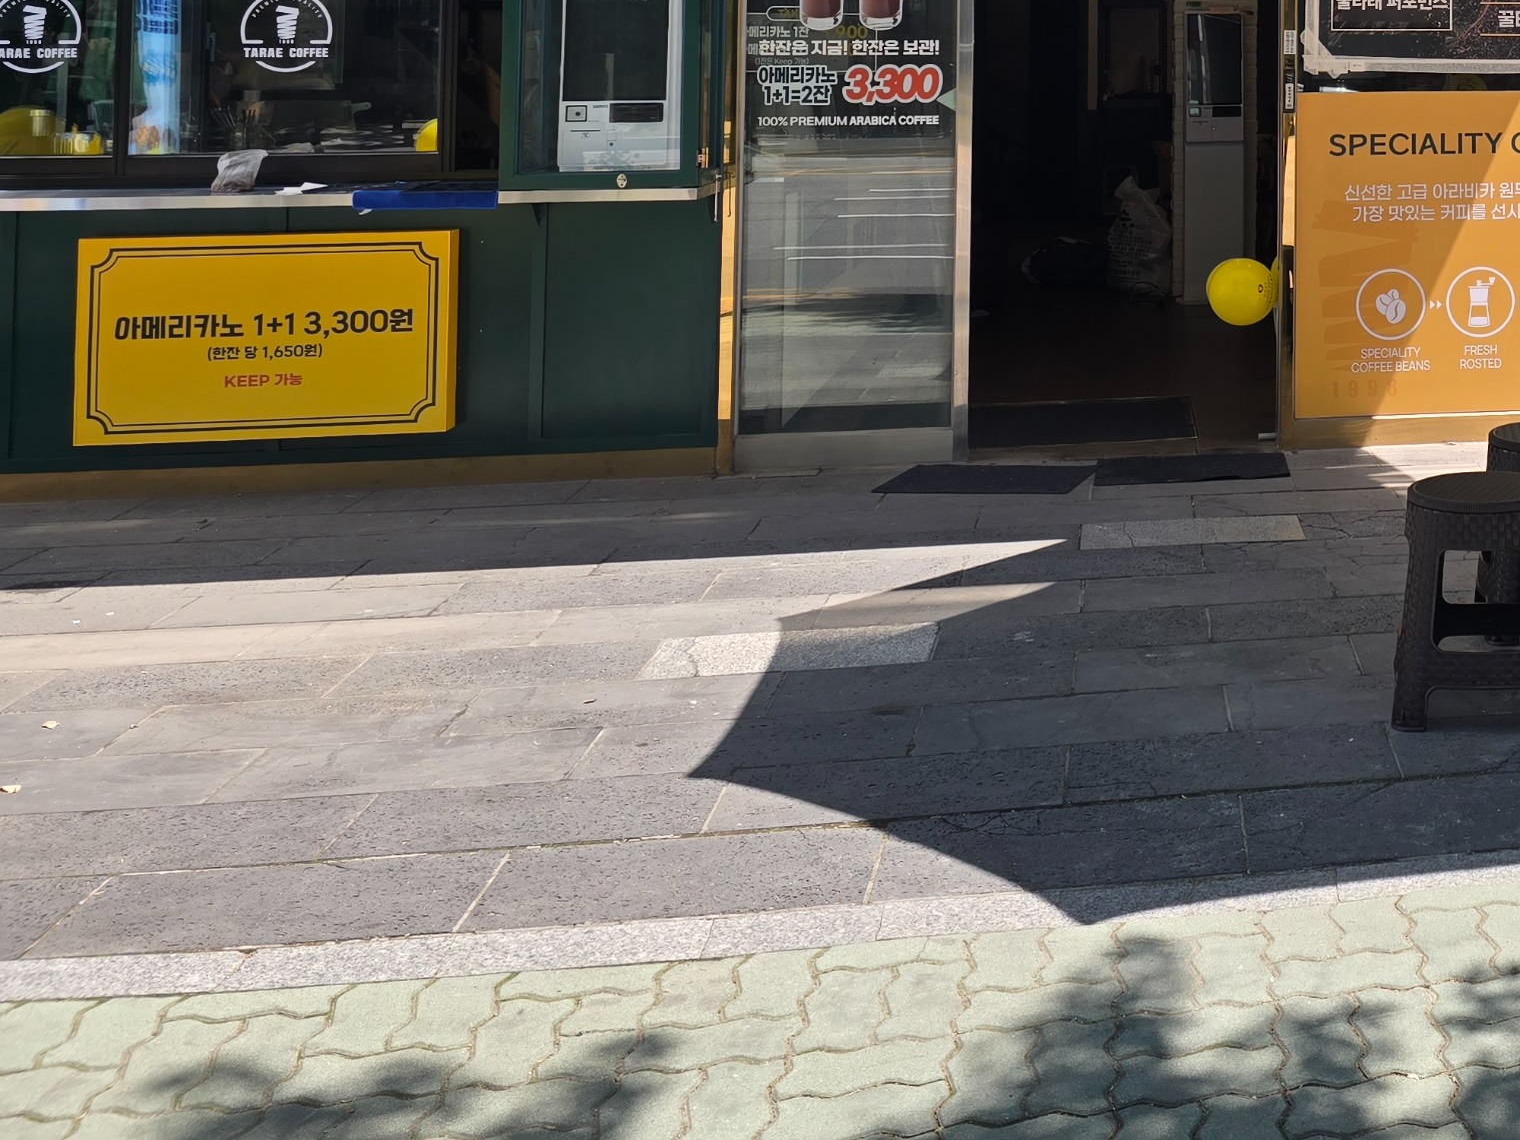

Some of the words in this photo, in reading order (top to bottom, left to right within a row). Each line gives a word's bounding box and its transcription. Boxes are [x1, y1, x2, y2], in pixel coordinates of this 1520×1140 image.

[746, 26, 791, 38] 메리카노
[0, 47, 31, 59] ARAE
[36, 47, 78, 59] COFFEE
[243, 47, 284, 58] TARAE
[288, 47, 329, 58] COFFEE
[811, 39, 848, 56] 지금!
[852, 39, 900, 56] 한잔은
[902, 39, 940, 56] 보관!
[757, 66, 838, 85] 아메리카노
[844, 66, 941, 104] 3,300
[763, 85, 831, 104] 1+1=2잔
[757, 115, 788, 127] 100%
[790, 115, 848, 127] PREMIUM
[849, 114, 897, 126] ARABICA
[897, 114, 940, 126] COFFEE
[1328, 132, 1503, 157] SPECIALITY
[1344, 183, 1393, 202] 신선한
[1396, 183, 1428, 201] 고급
[1432, 182, 1496, 201] 아라비카
[1352, 205, 1385, 223] 가장
[1388, 204, 1436, 222] 맛있는
[1440, 203, 1487, 221] 커피를
[113, 313, 245, 341] 아메리카노
[253, 312, 296, 337] 1+1
[303, 308, 414, 340] 3,300원
[207, 345, 240, 361] (한잔
[244, 345, 258, 360] 당
[262, 343, 323, 360] 1,650원)
[1360, 346, 1421, 360] SPECIALITY
[1463, 344, 1498, 356] FRESH
[1350, 361, 1393, 373] COFFEE
[1395, 360, 1431, 372] BEANS
[1459, 358, 1502, 370] ROSTED
[224, 374, 271, 388] KEEP
[274, 372, 303, 387] 가능
